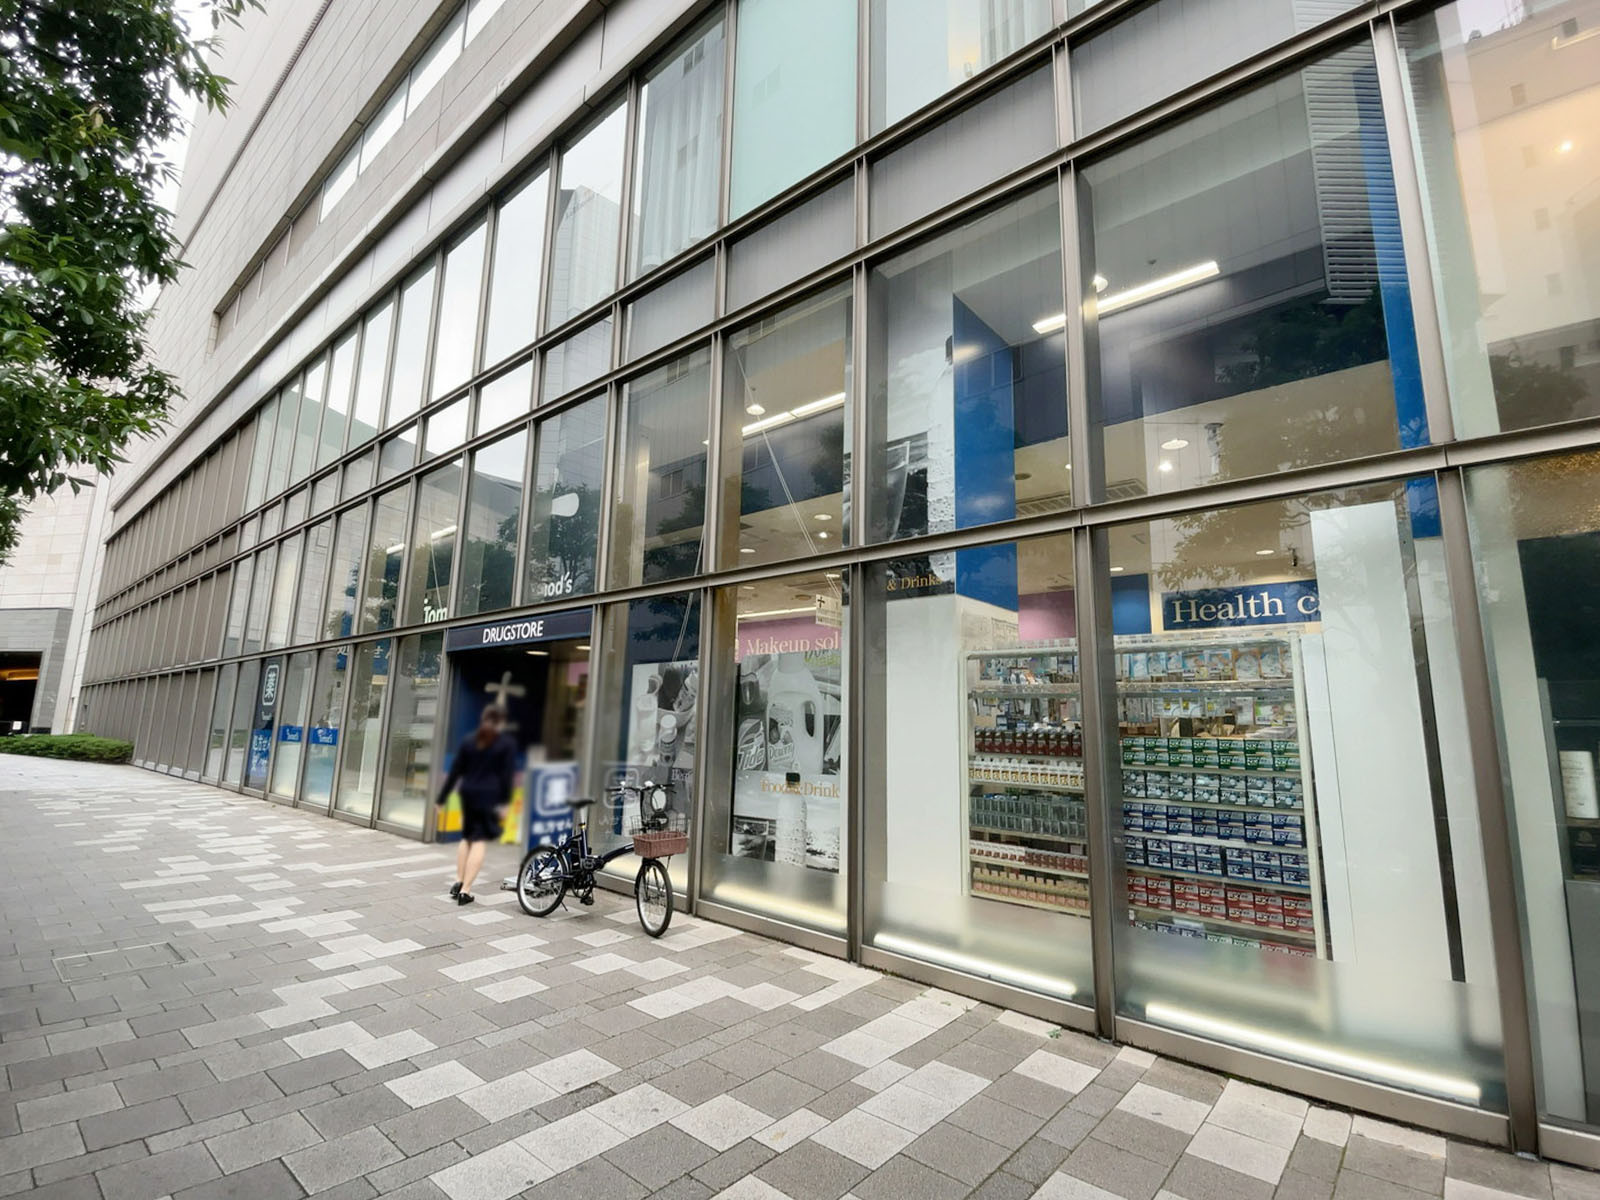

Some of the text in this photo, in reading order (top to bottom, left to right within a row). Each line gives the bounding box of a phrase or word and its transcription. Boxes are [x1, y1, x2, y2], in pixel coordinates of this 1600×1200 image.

[1172, 591, 1286, 623] Health
[482, 620, 544, 643] DRUGSTORE
[746, 636, 810, 656] Makeup
[738, 743, 765, 770] Tide
